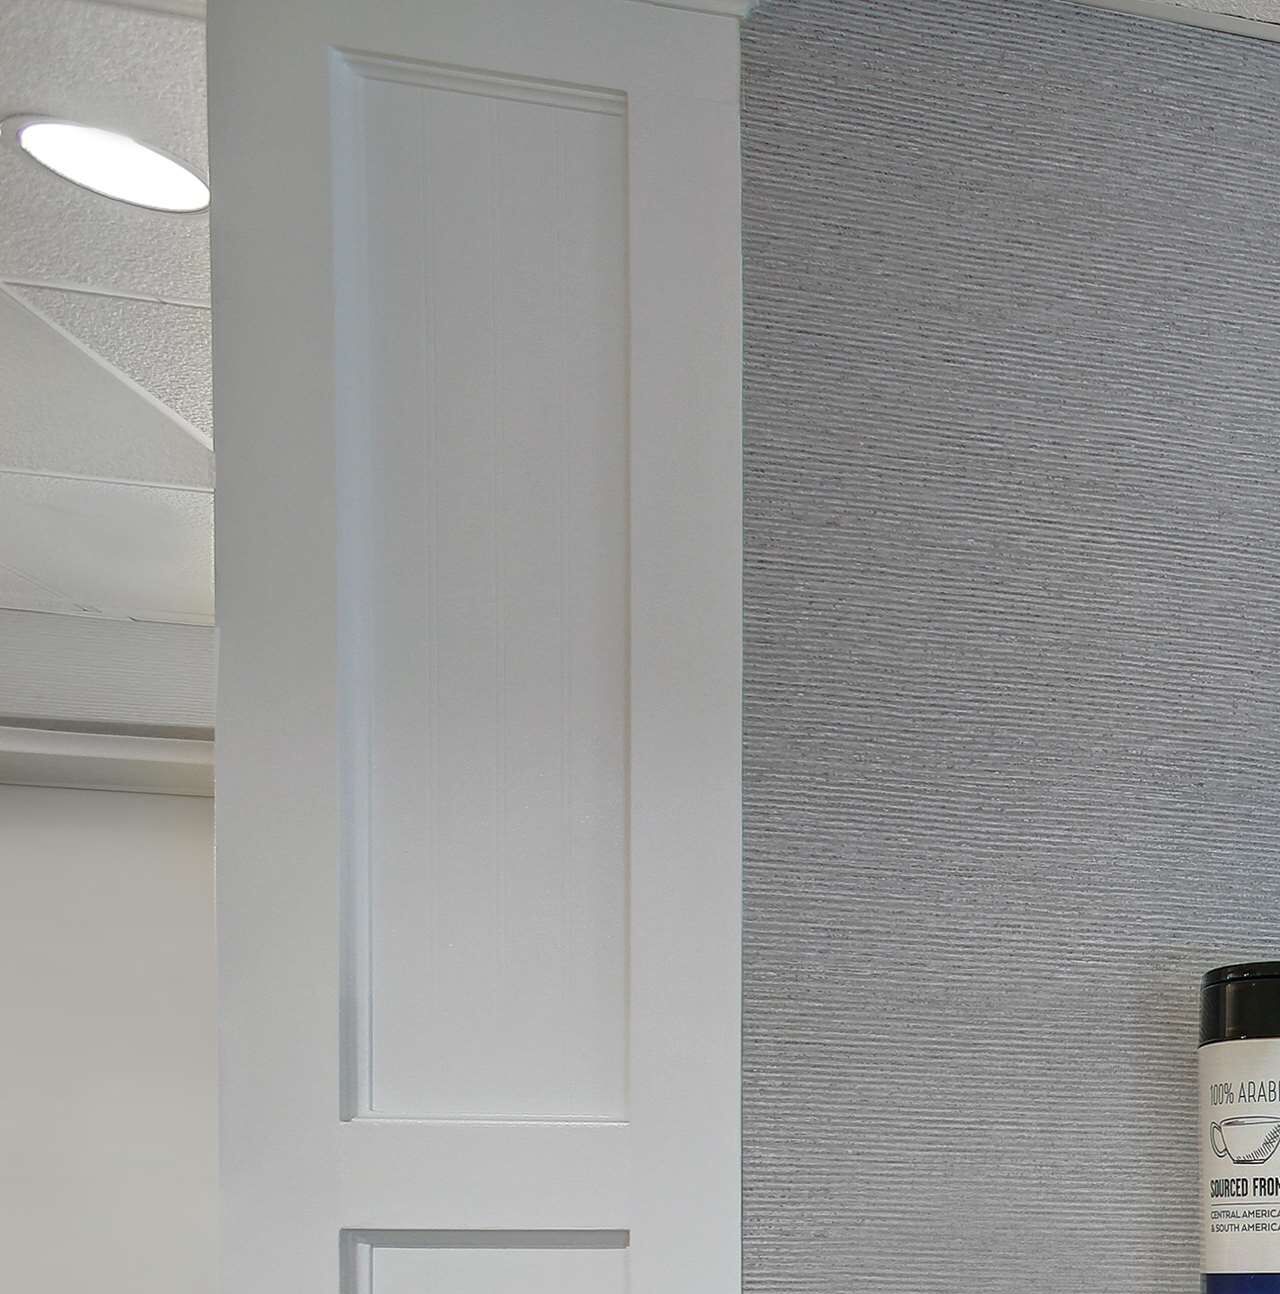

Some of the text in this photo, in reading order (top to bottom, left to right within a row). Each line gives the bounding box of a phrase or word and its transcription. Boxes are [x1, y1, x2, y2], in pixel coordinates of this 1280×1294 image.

[1210, 1083, 1234, 1105] 100%
[1210, 1178, 1248, 1198] SOURCED
[1211, 1210, 1240, 1220] CENTRAL
[1216, 1223, 1240, 1232] SOUTH
